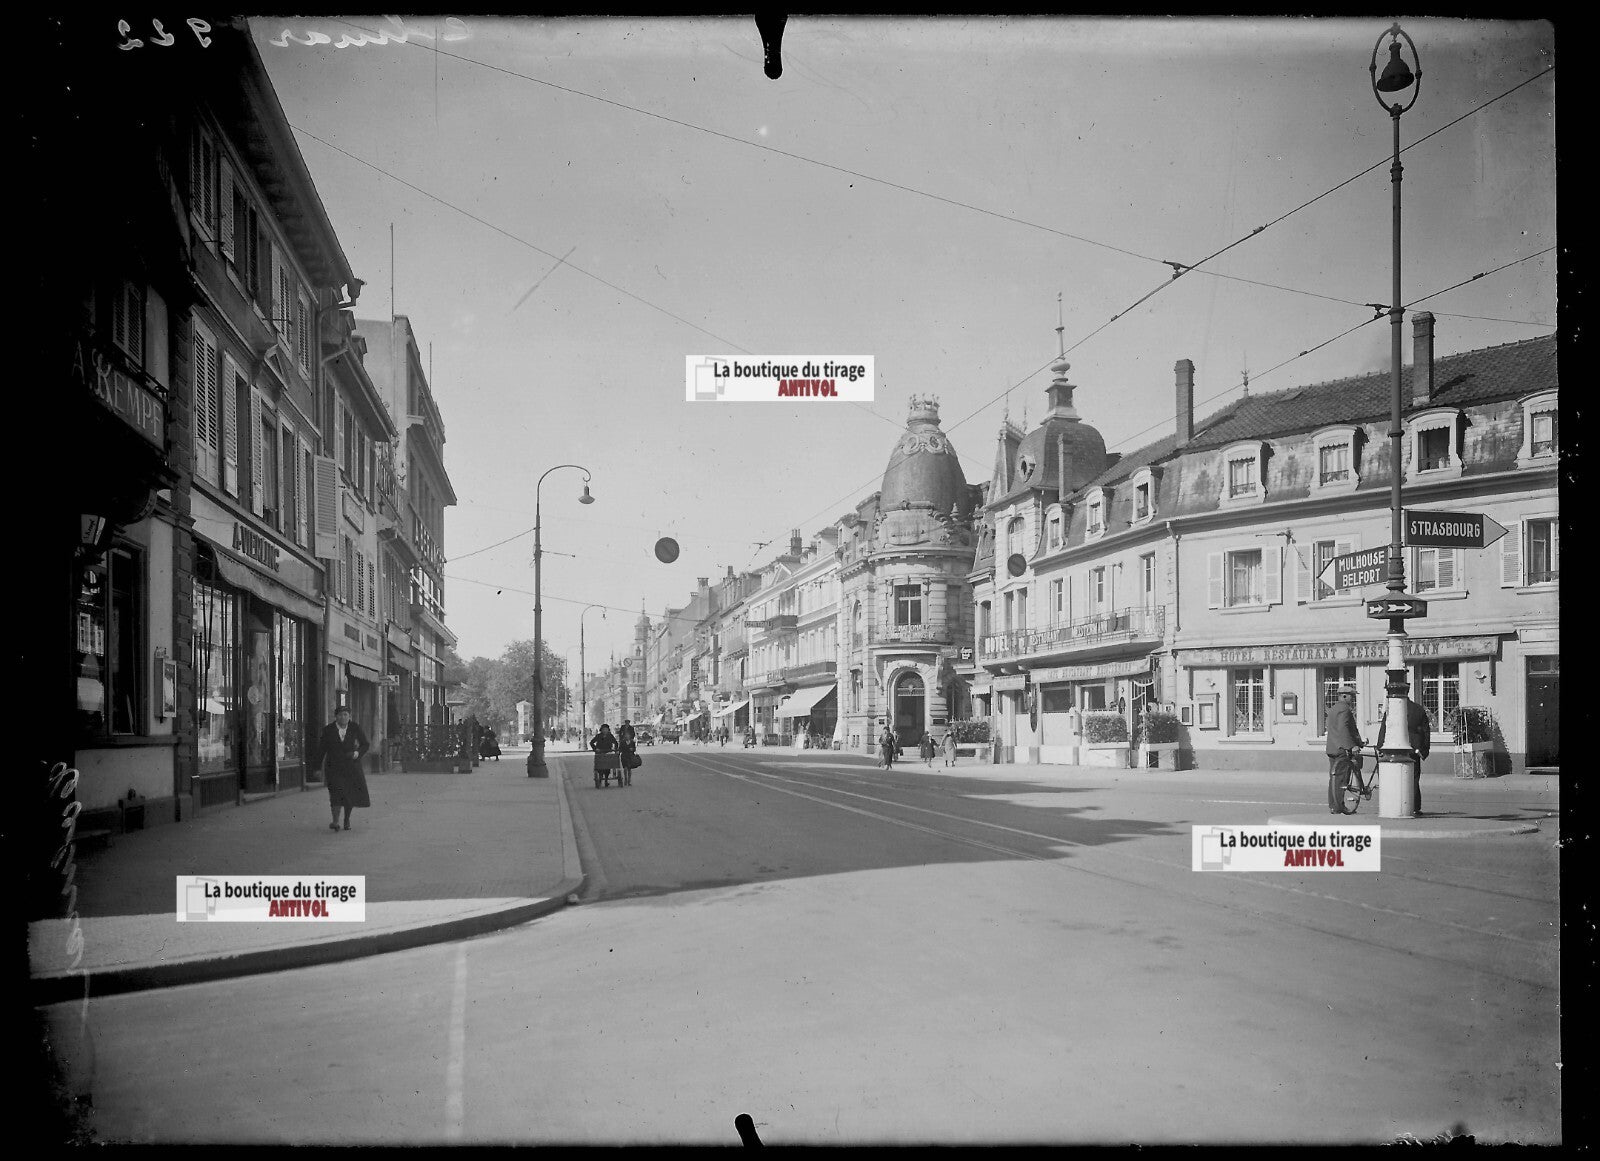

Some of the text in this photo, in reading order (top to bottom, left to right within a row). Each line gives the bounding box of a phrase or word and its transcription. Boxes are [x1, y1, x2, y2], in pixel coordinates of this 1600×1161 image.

[1410, 520, 1481, 538] STRASBOURG
[1338, 550, 1385, 572] MULHOUSE
[1342, 568, 1382, 587] BELFORT
[1264, 647, 1338, 661] RESTAURANT
[1346, 643, 1440, 659] MEISTMANN
